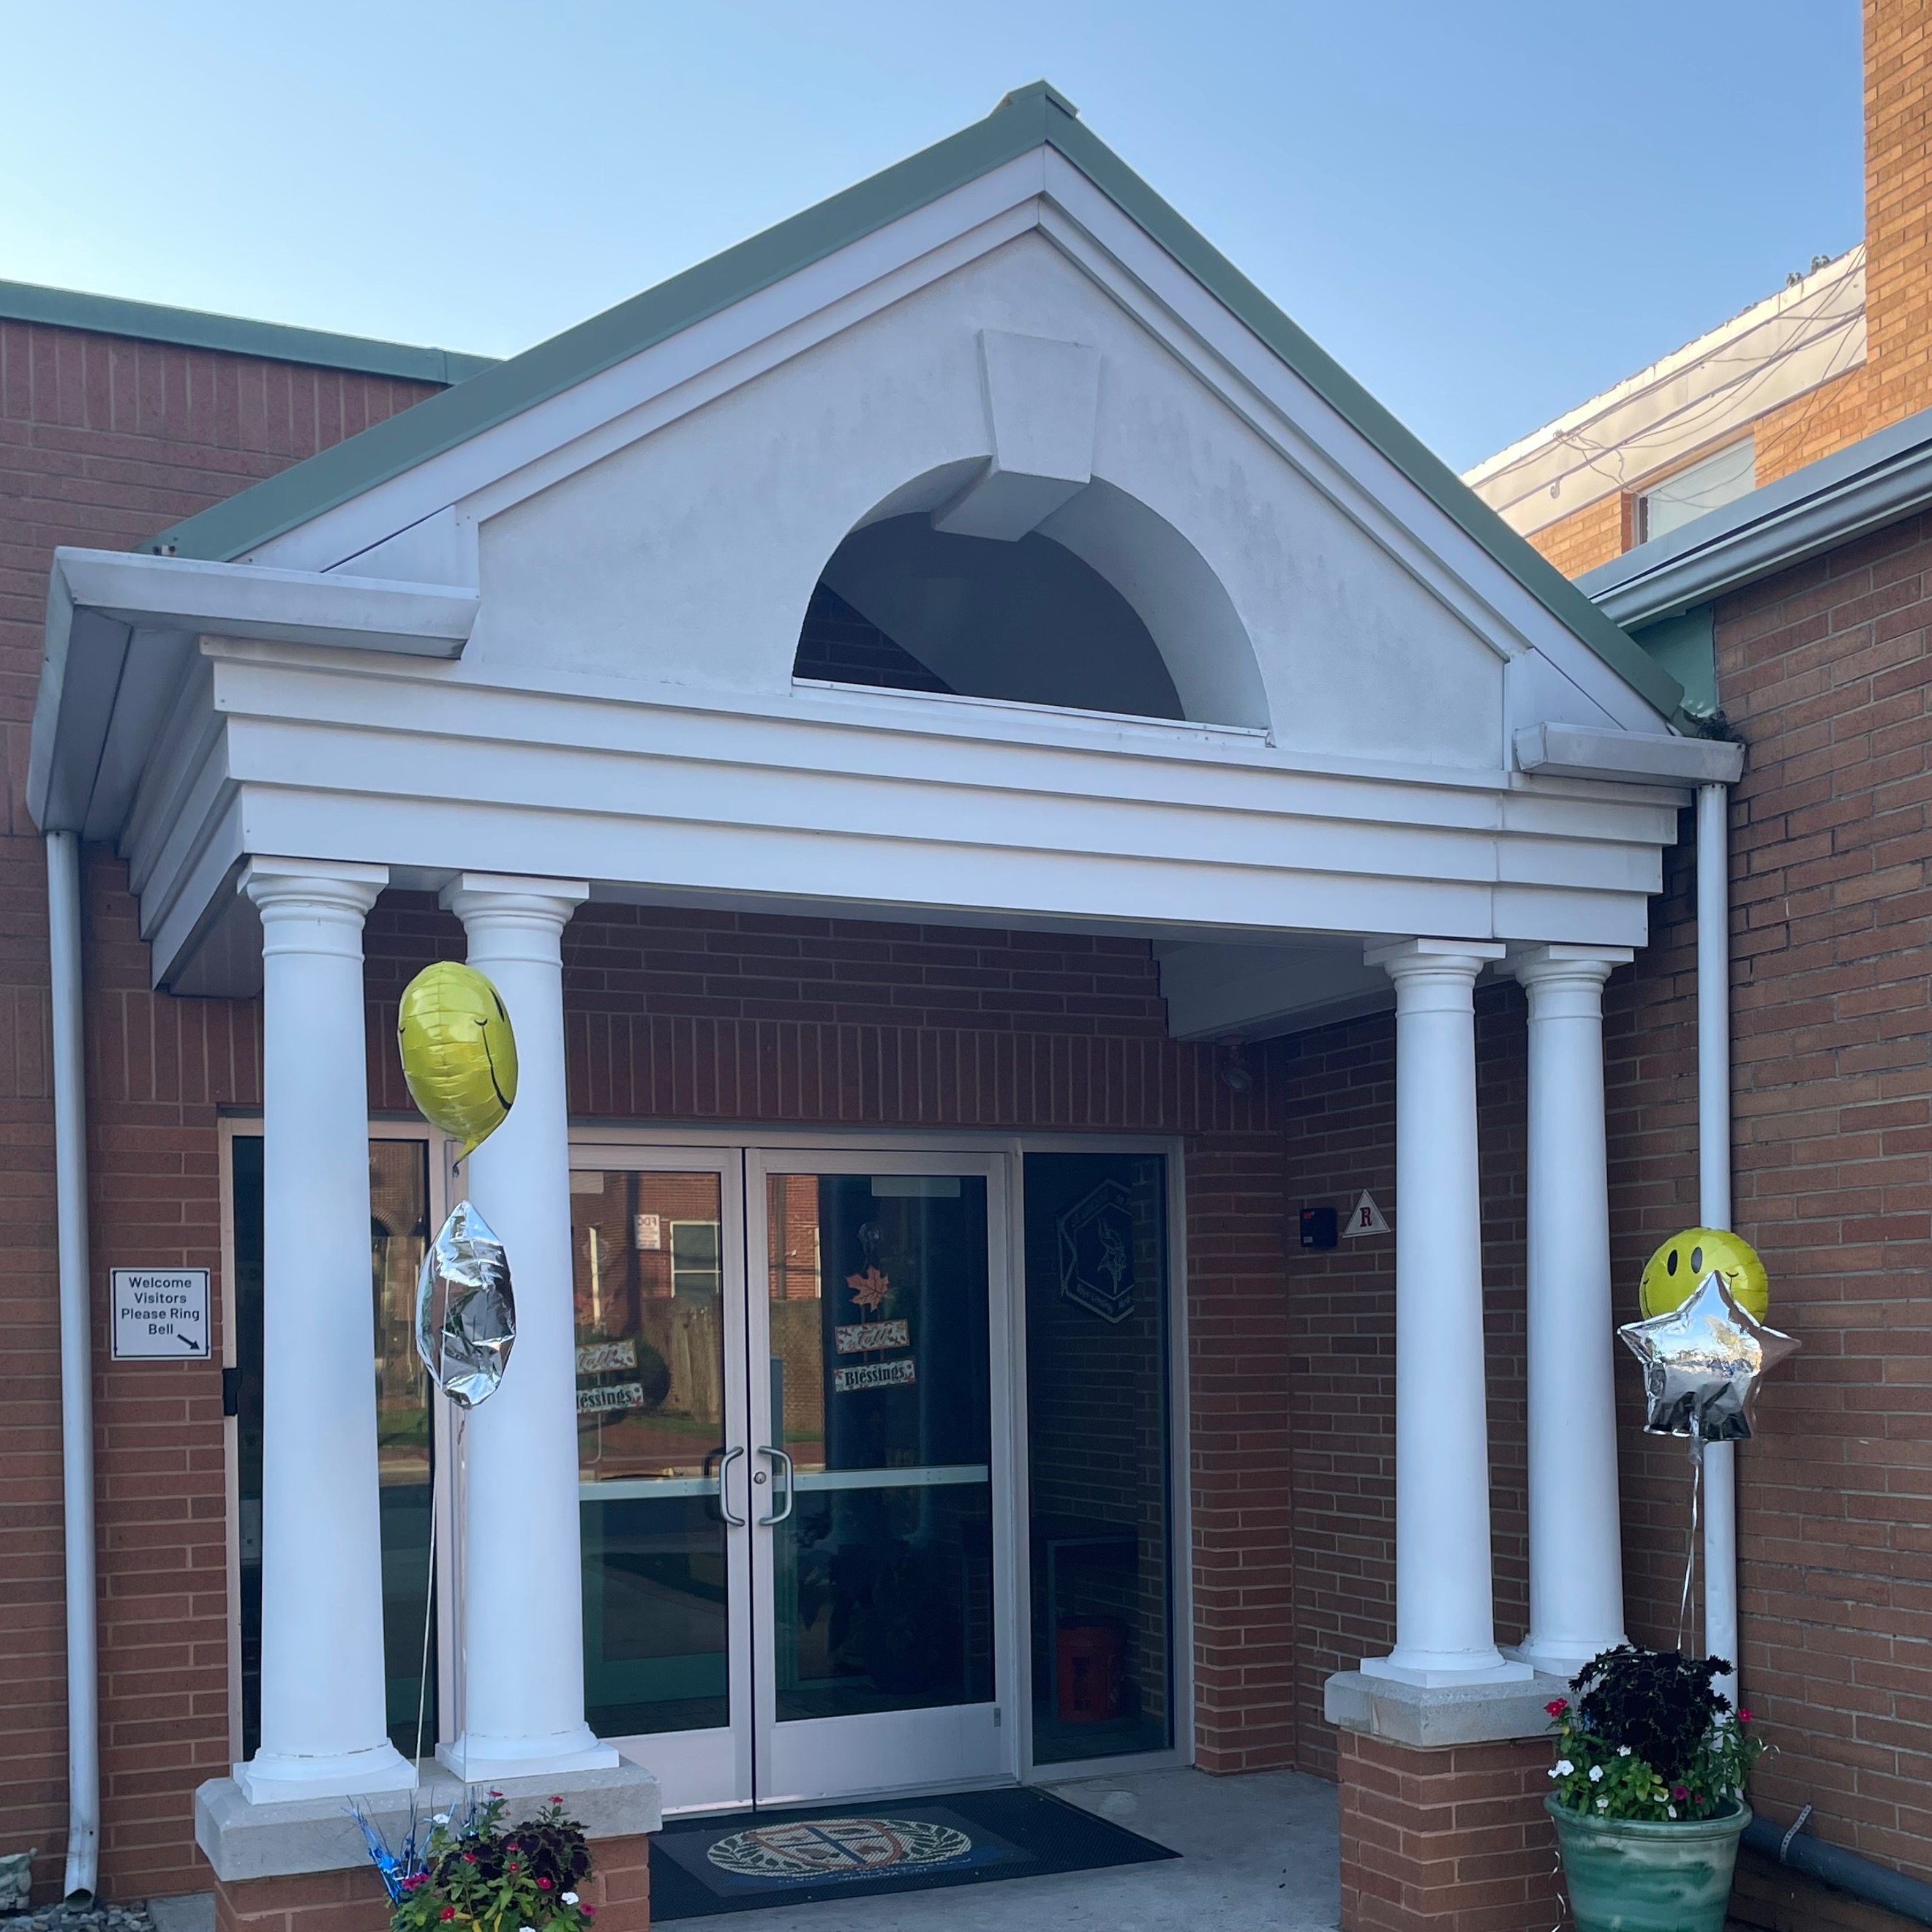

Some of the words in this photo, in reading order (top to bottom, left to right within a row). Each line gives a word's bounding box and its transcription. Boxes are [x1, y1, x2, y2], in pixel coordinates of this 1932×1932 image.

[1360, 1207, 1372, 1228] R
[129, 1277, 192, 1288] Welcome
[134, 1292, 187, 1304] Visitors
[121, 1308, 166, 1319] Please
[170, 1307, 200, 1322] Ring
[149, 1323, 173, 1335] Bell
[857, 1328, 887, 1345] Fall
[579, 1350, 611, 1367] Fall
[844, 1365, 905, 1386] Blessings
[576, 1389, 631, 1408] lessings
